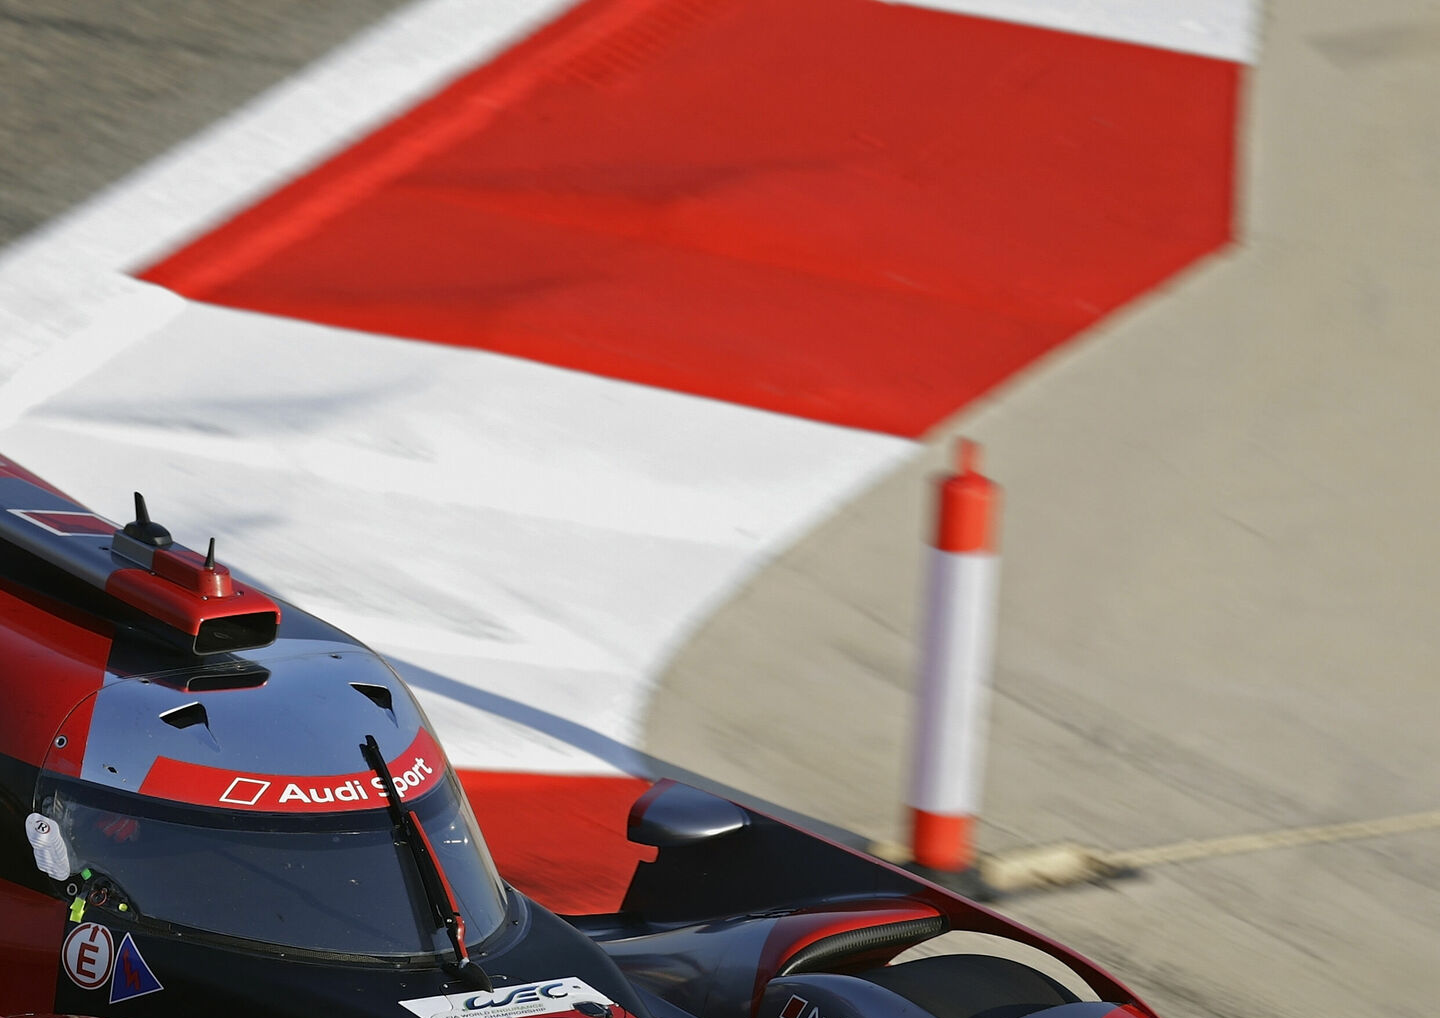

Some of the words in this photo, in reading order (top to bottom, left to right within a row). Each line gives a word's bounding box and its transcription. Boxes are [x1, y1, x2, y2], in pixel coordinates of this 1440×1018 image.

[278, 780, 369, 804] Audi
[371, 756, 433, 799] Sport
[76, 941, 99, 979] E
[461, 1010, 491, 1018] WORLD
[491, 1003, 544, 1014] ENDURANCE
[465, 982, 568, 1010] WEC
